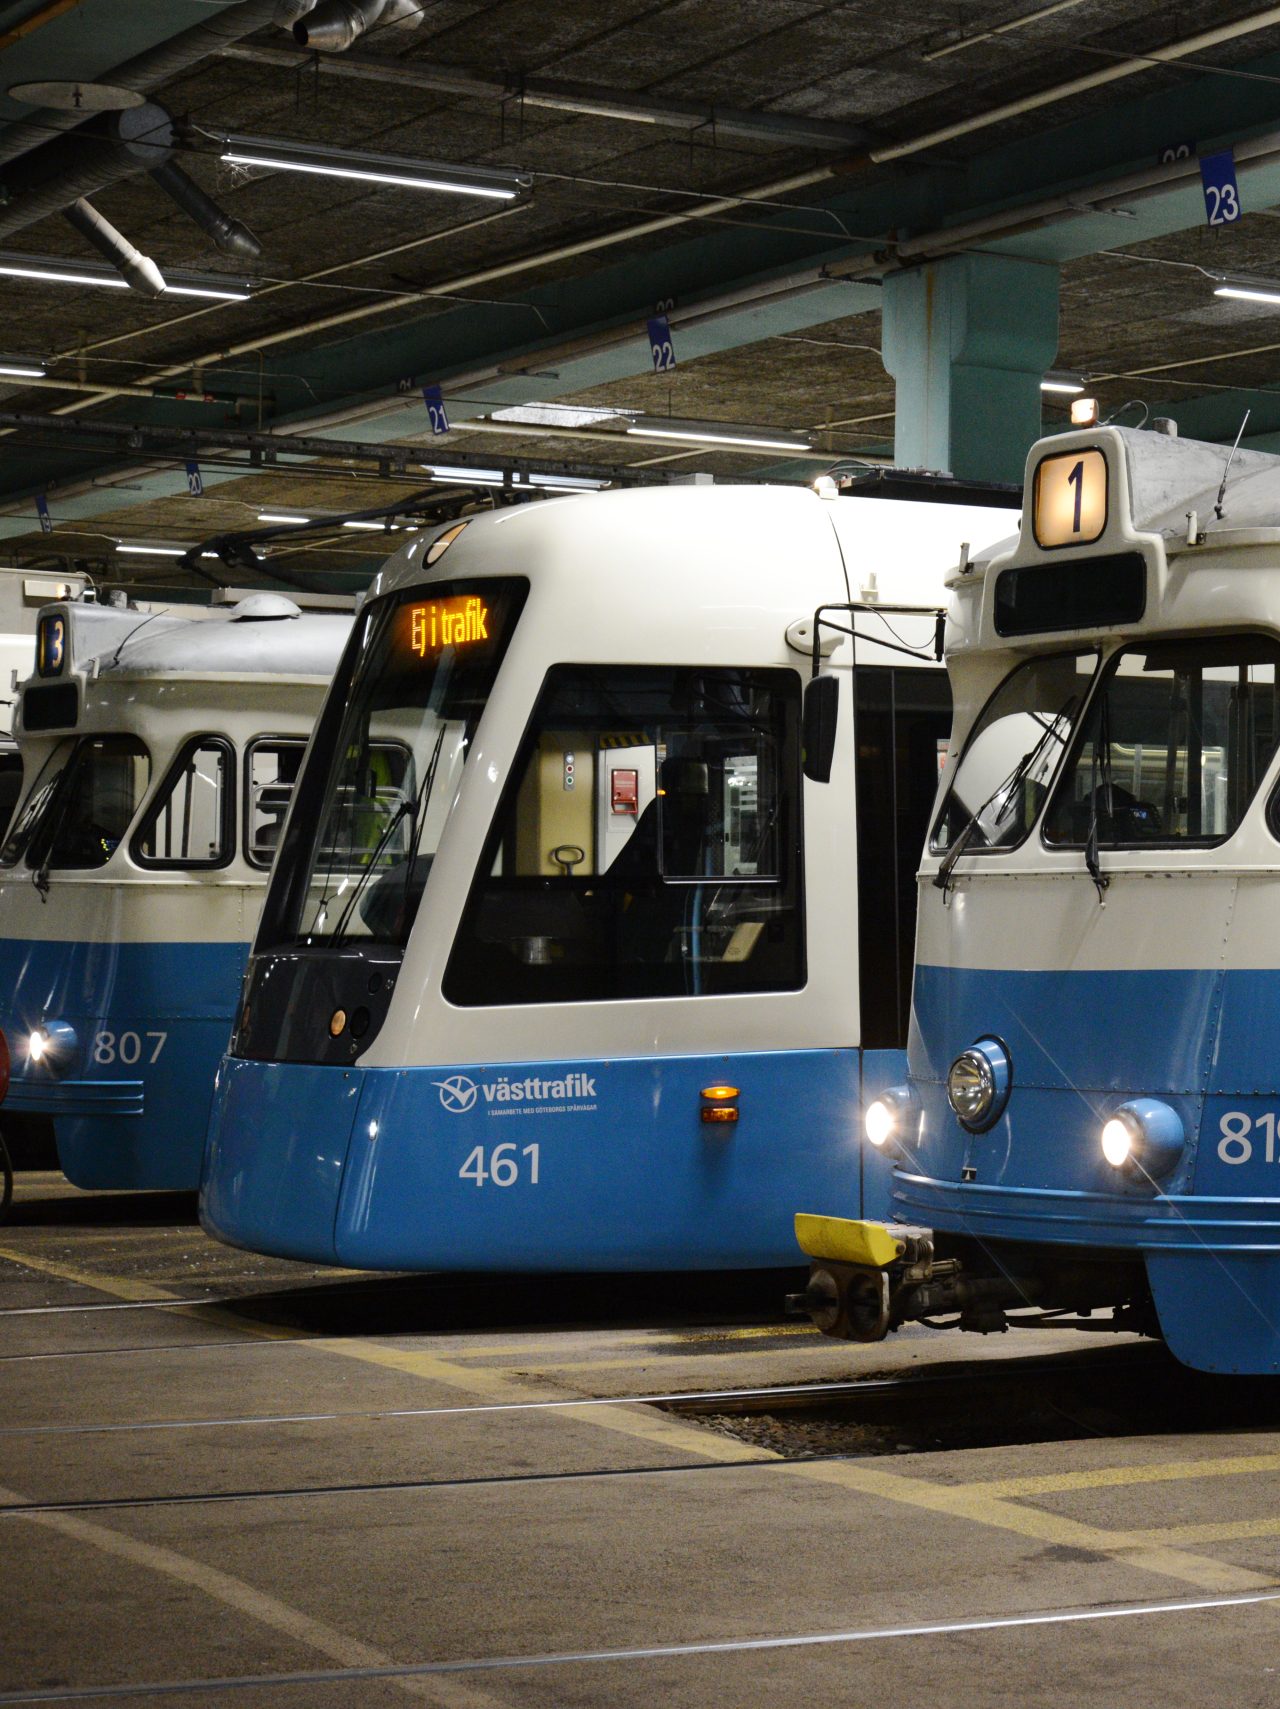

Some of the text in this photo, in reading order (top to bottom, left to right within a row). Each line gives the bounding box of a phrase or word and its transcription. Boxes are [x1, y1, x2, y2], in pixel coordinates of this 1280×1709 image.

[1206, 184, 1239, 226] 23
[652, 342, 676, 372] 22
[429, 405, 449, 433] 21
[187, 472, 202, 495] 20
[1067, 460, 1084, 533] 1
[52, 620, 64, 668] 3
[411, 598, 488, 657] Ej i trafik
[94, 1031, 168, 1065] 807
[482, 1073, 597, 1102] västtrafik
[523, 1106, 535, 1114] MED
[459, 1143, 540, 1187] 461
